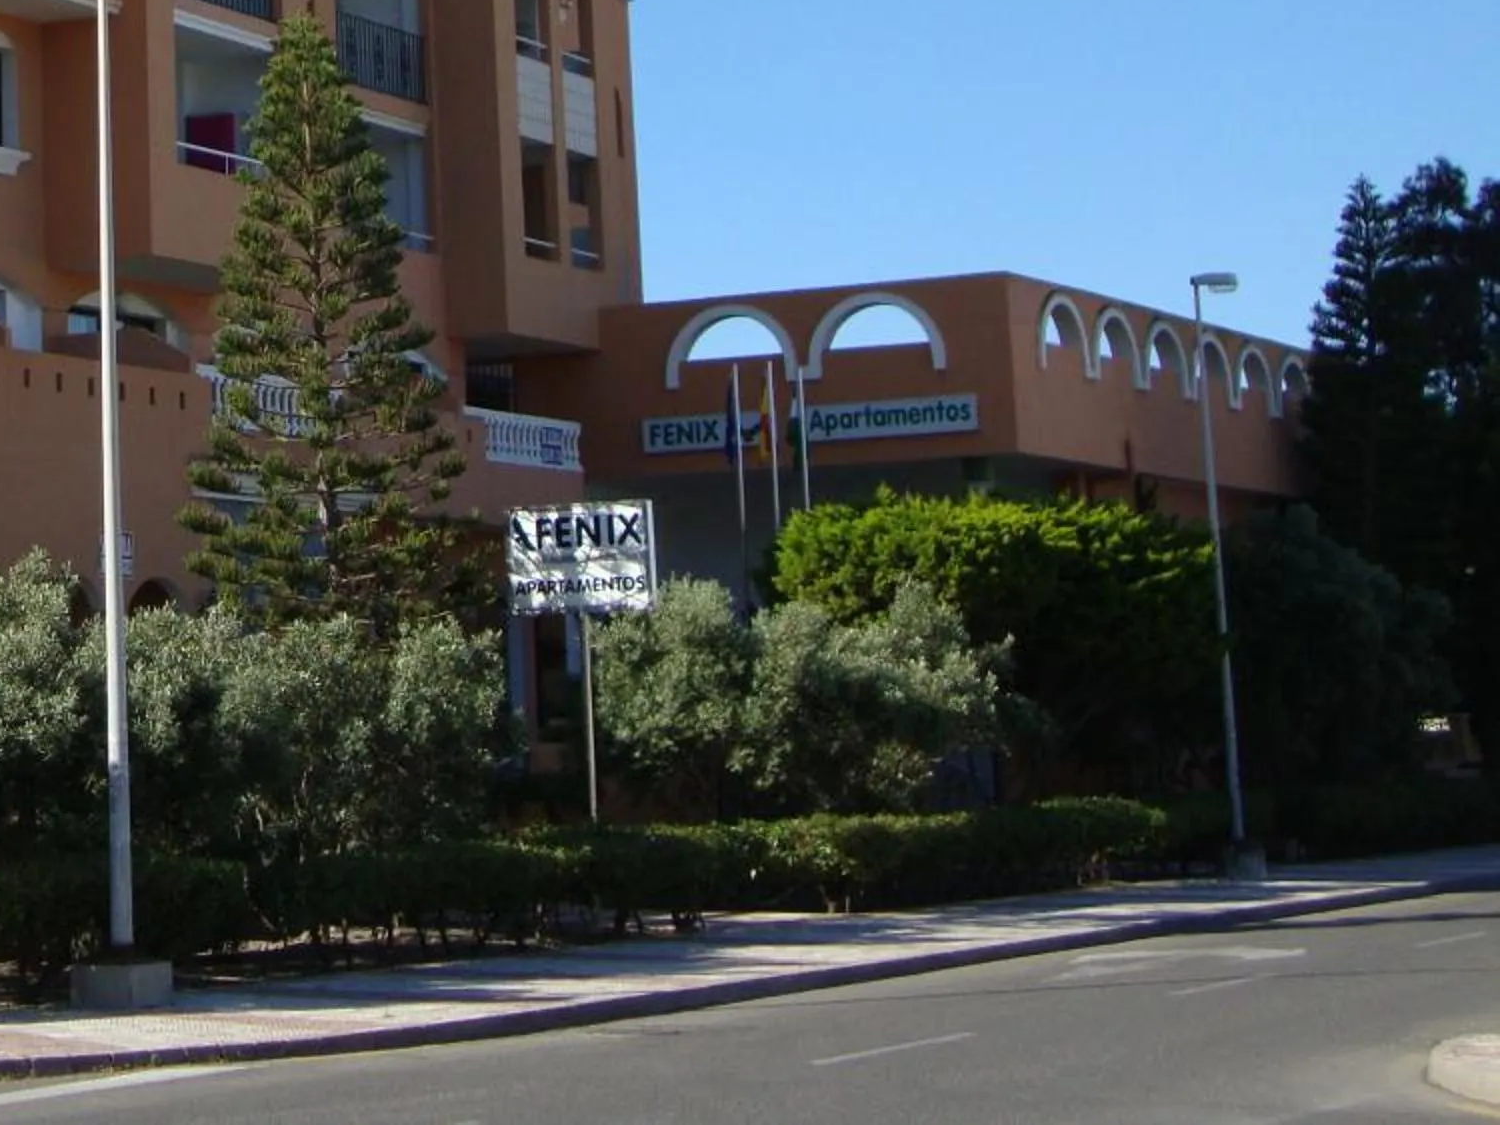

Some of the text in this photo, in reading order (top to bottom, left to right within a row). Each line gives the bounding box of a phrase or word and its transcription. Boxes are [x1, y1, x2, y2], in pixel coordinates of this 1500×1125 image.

[649, 401, 971, 447] FENIX Apartamentos
[535, 512, 642, 549] FENIX
[515, 575, 646, 596] APARTAMENTOS
